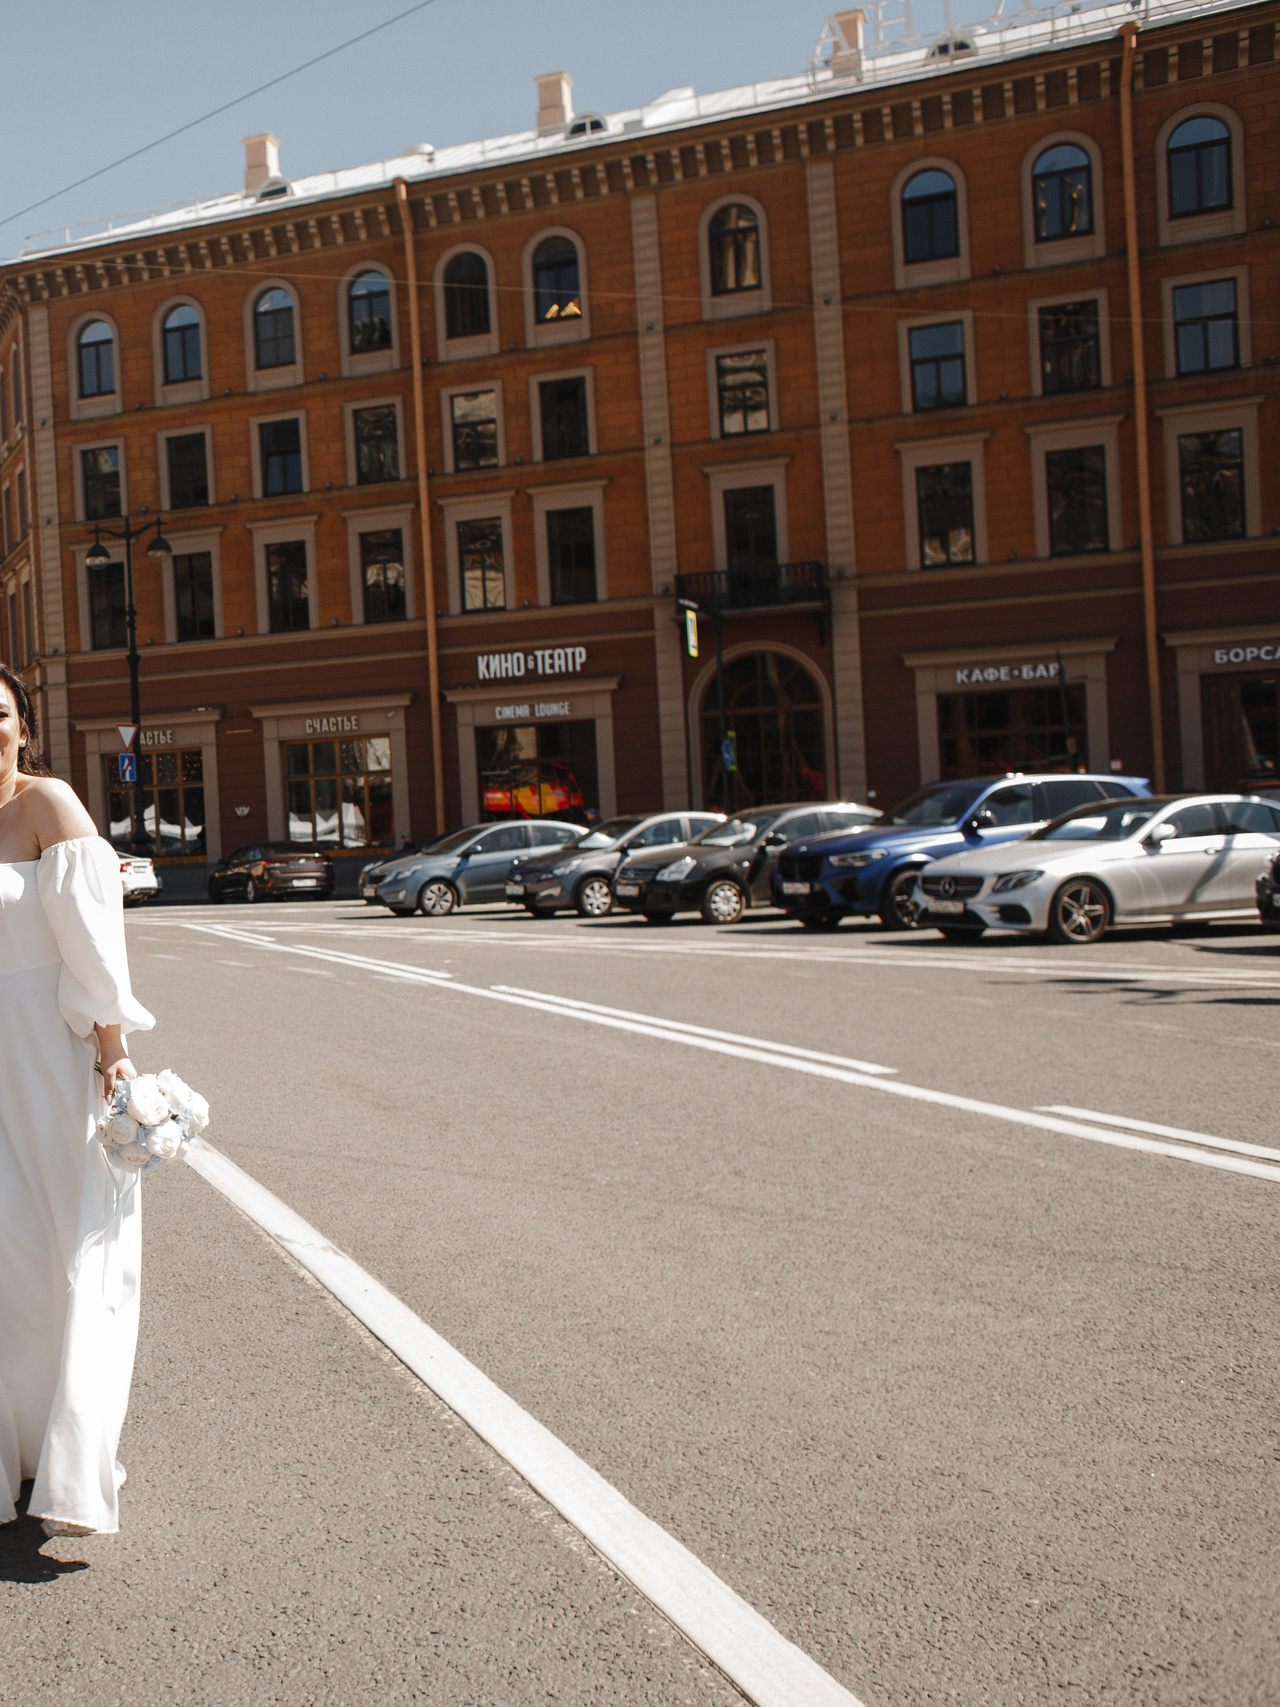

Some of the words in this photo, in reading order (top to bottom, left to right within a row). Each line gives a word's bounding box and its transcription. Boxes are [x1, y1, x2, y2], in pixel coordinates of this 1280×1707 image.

[495, 704, 530, 720] CINEMA
[534, 701, 570, 718] LOUNGE
[305, 715, 359, 734] СЧАСТЬЕ
[140, 729, 173, 746] АСТЬЕ
